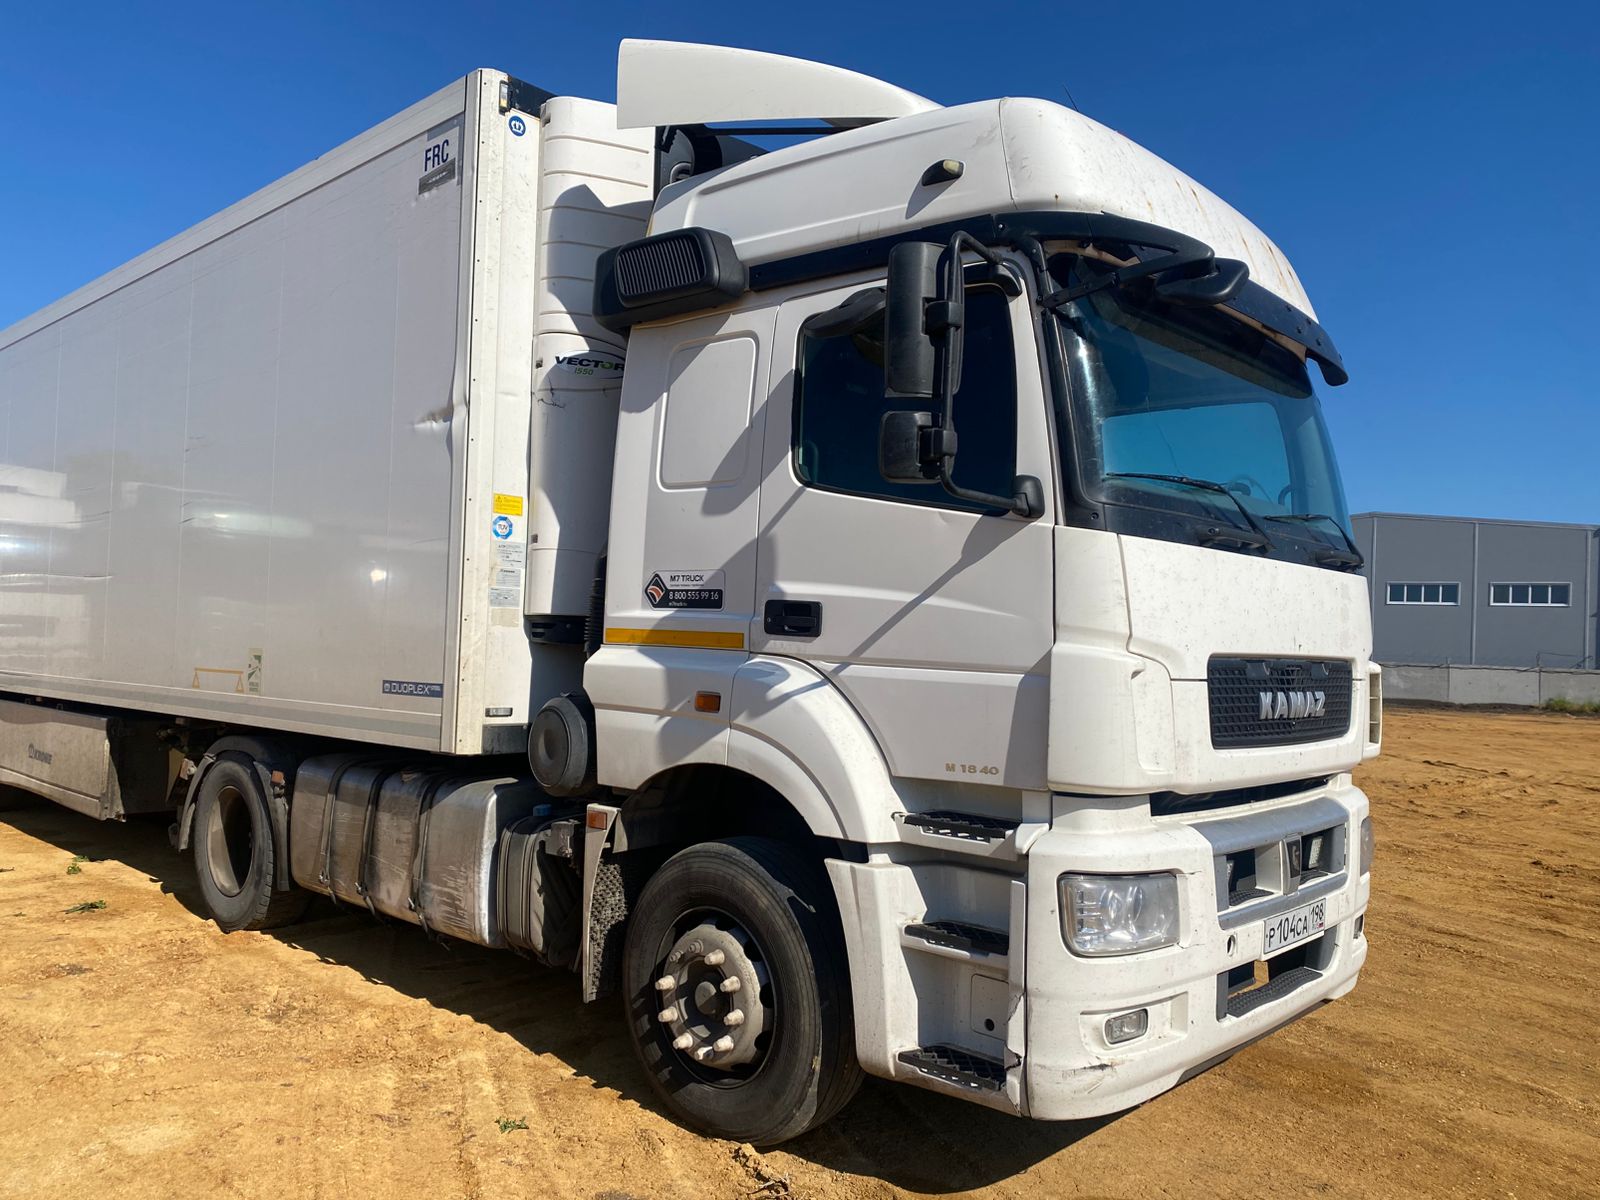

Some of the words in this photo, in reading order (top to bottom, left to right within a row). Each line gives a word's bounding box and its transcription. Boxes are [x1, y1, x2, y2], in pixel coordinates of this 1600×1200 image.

[425, 139, 449, 171] FRC
[555, 356, 625, 371] VECTOR
[669, 591, 674, 600] 8
[675, 591, 687, 600] 800
[687, 591, 700, 600] 555
[701, 591, 710, 600] 99
[711, 591, 719, 600] 16
[1260, 691, 1325, 719] KAMAZ
[960, 764, 999, 775] 1840
